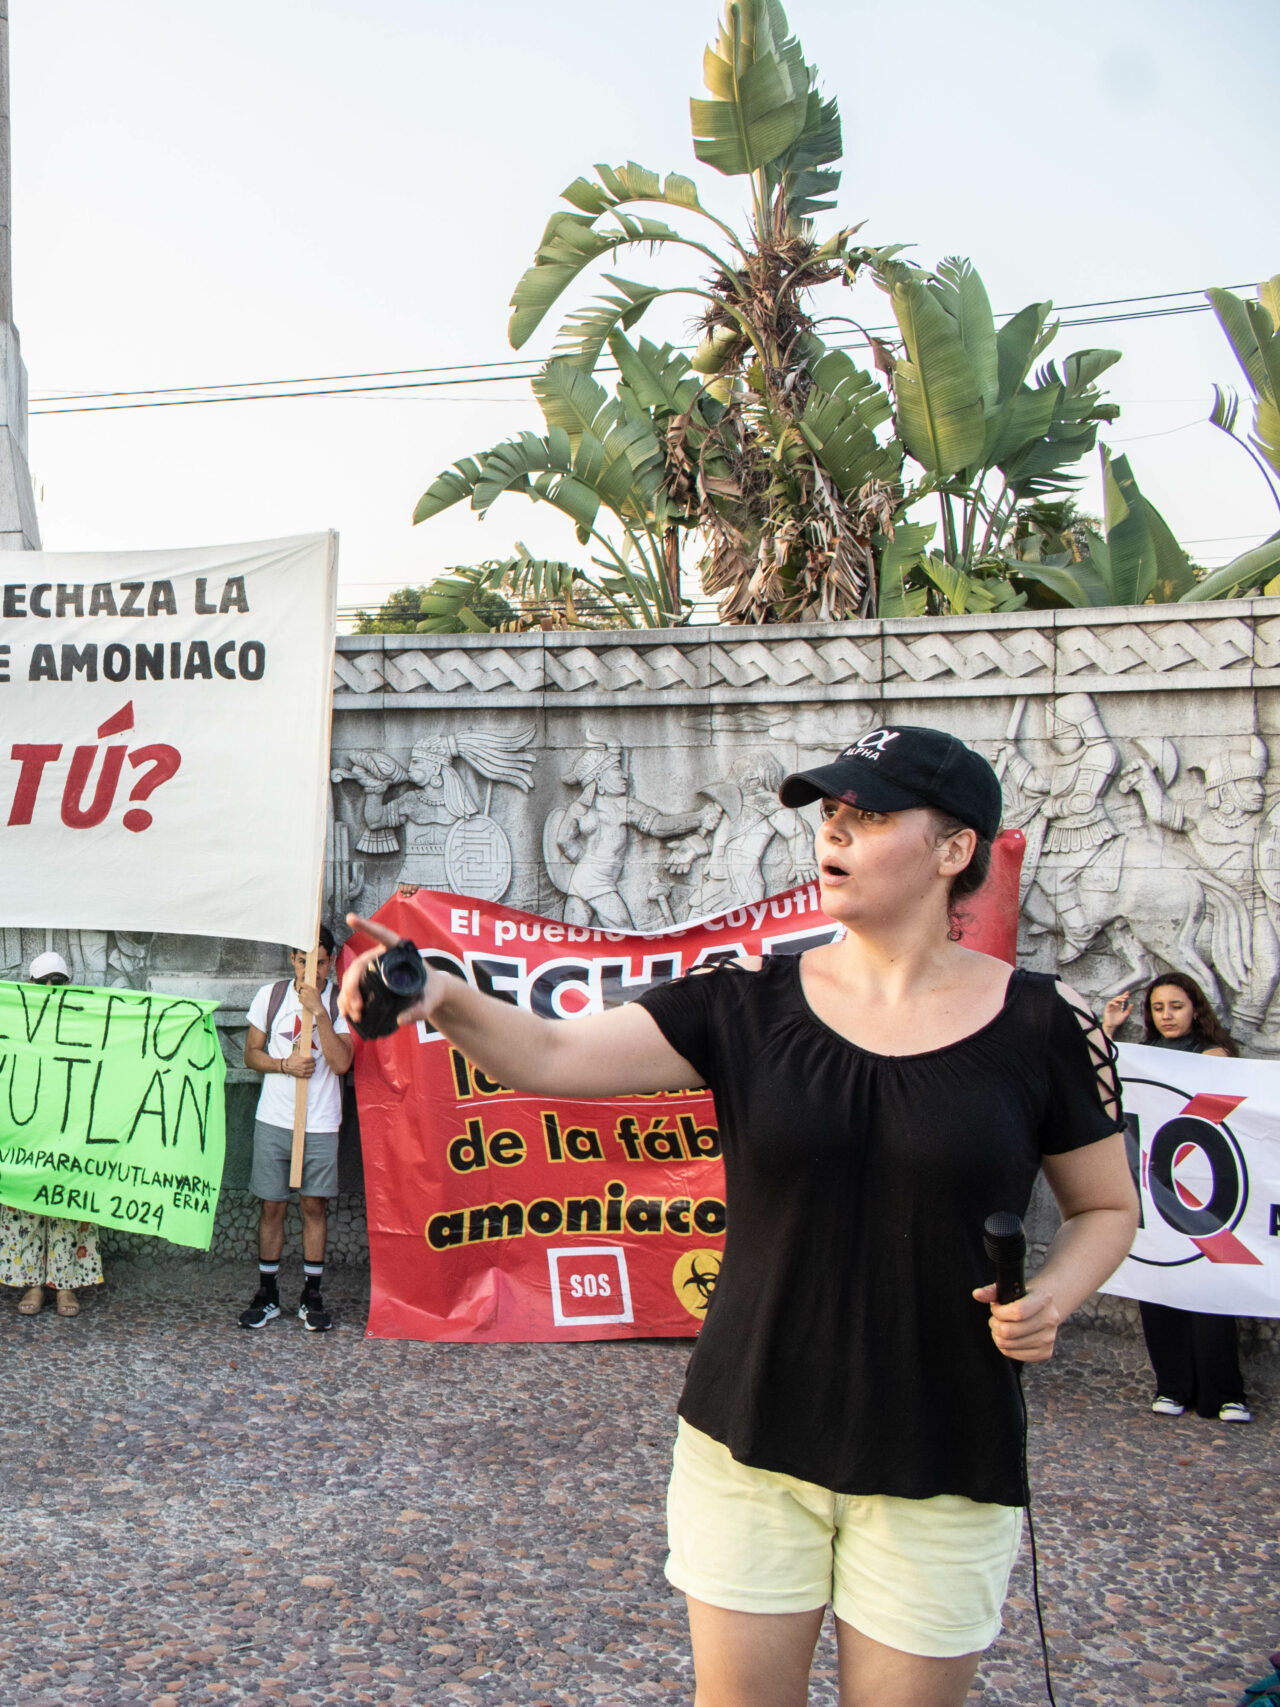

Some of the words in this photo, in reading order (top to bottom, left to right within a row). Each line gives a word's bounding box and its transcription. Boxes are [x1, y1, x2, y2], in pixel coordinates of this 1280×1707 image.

[194, 574, 250, 616] LA
[28, 639, 266, 683] AMONIACO
[6, 699, 182, 833] TÚ?
[843, 747, 881, 761] ALPHA
[450, 908, 480, 936] El
[447, 1116, 527, 1175] de
[540, 1110, 607, 1164] la
[33, 1185, 100, 1213] ABRIL
[110, 1196, 164, 1231] 2024
[425, 1180, 728, 1251] amoniaco
[569, 1273, 611, 1298] SOS
